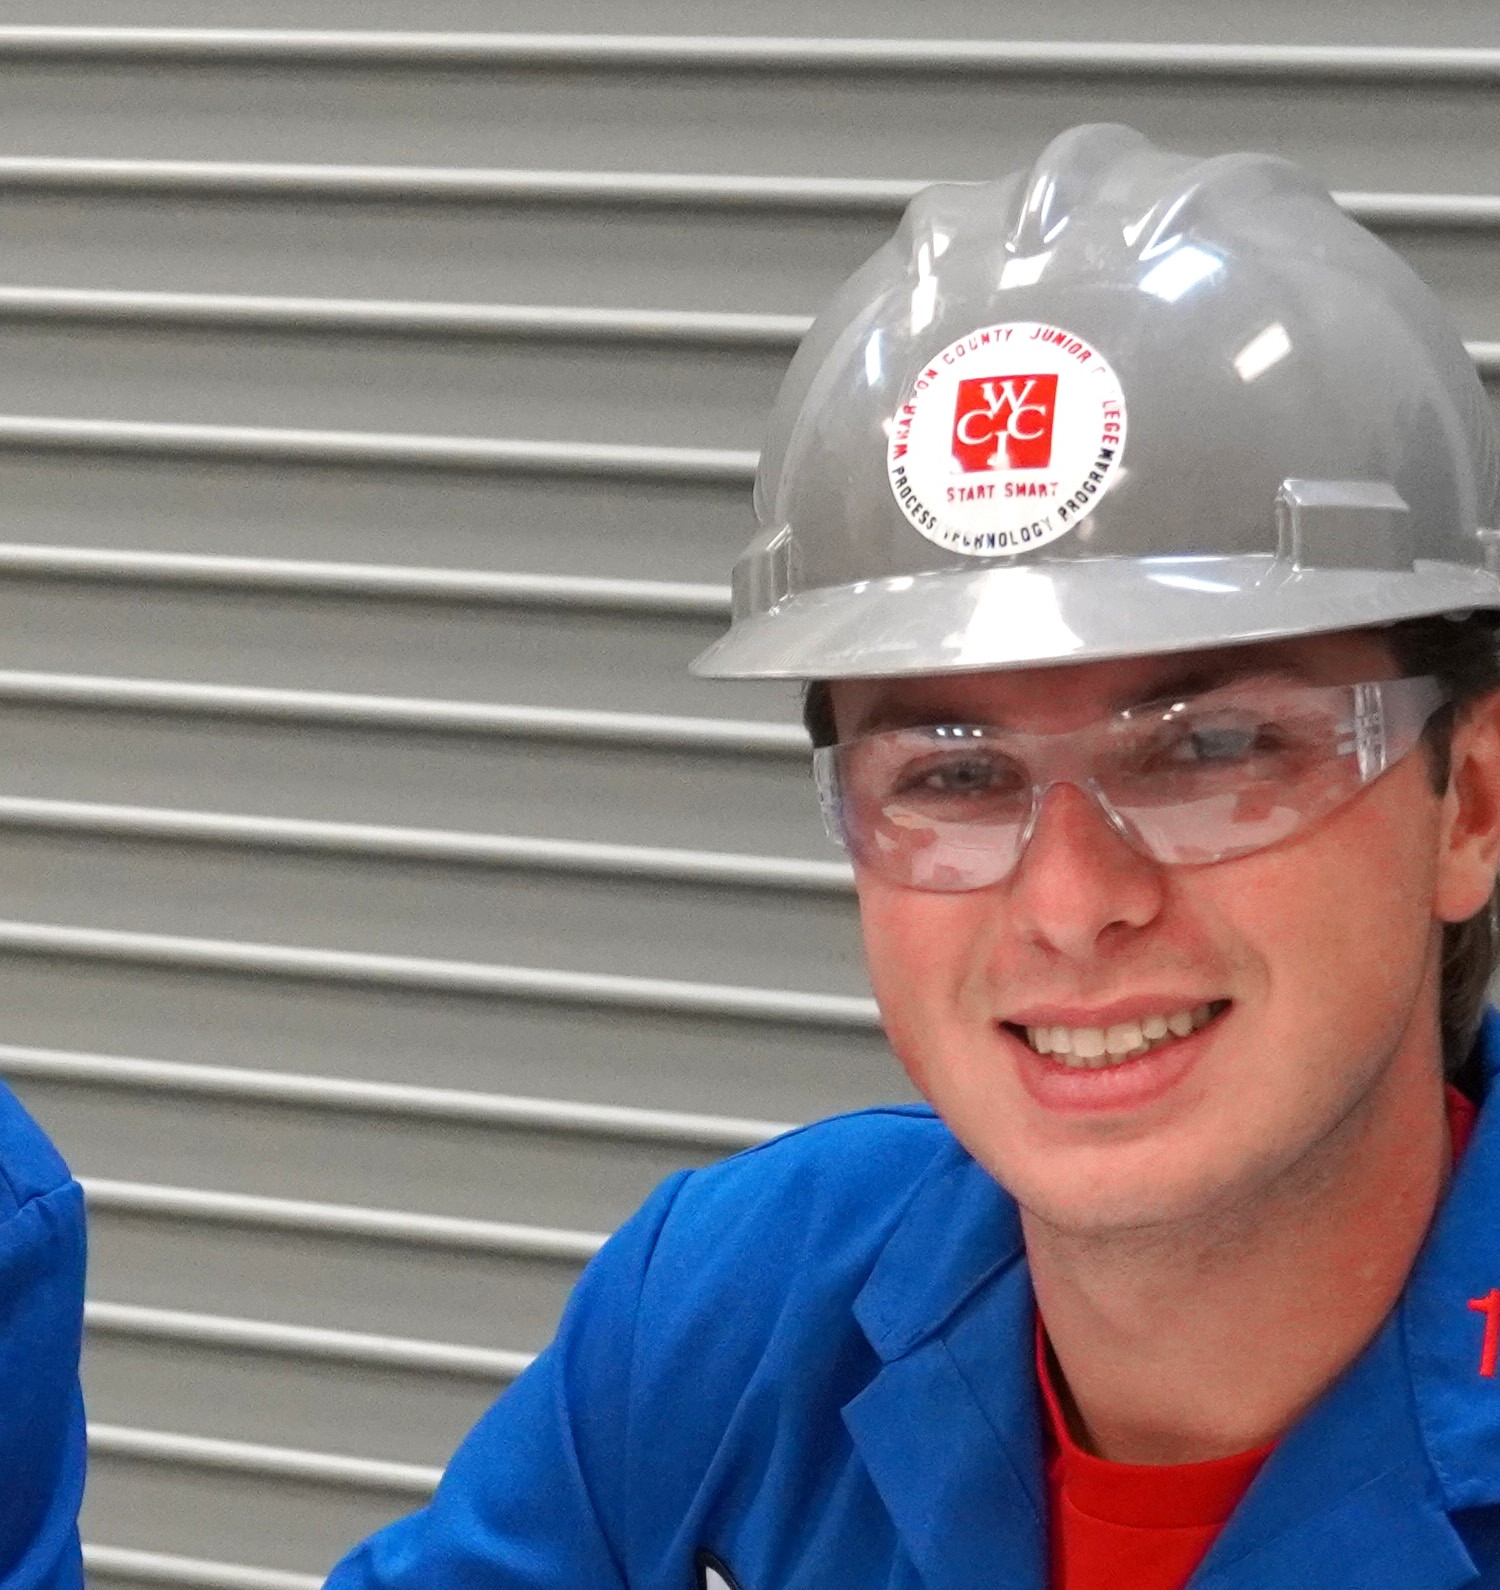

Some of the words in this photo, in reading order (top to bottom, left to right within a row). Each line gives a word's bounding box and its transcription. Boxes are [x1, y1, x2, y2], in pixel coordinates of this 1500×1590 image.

[892, 367, 938, 461] WHARON
[942, 329, 1014, 365] COUNTY
[1029, 326, 1093, 364] JUNIOR
[891, 465, 937, 531] PROCESS
[1057, 447, 1115, 522] PROGRAM
[946, 483, 996, 503] START
[1004, 481, 1060, 498] SMART
